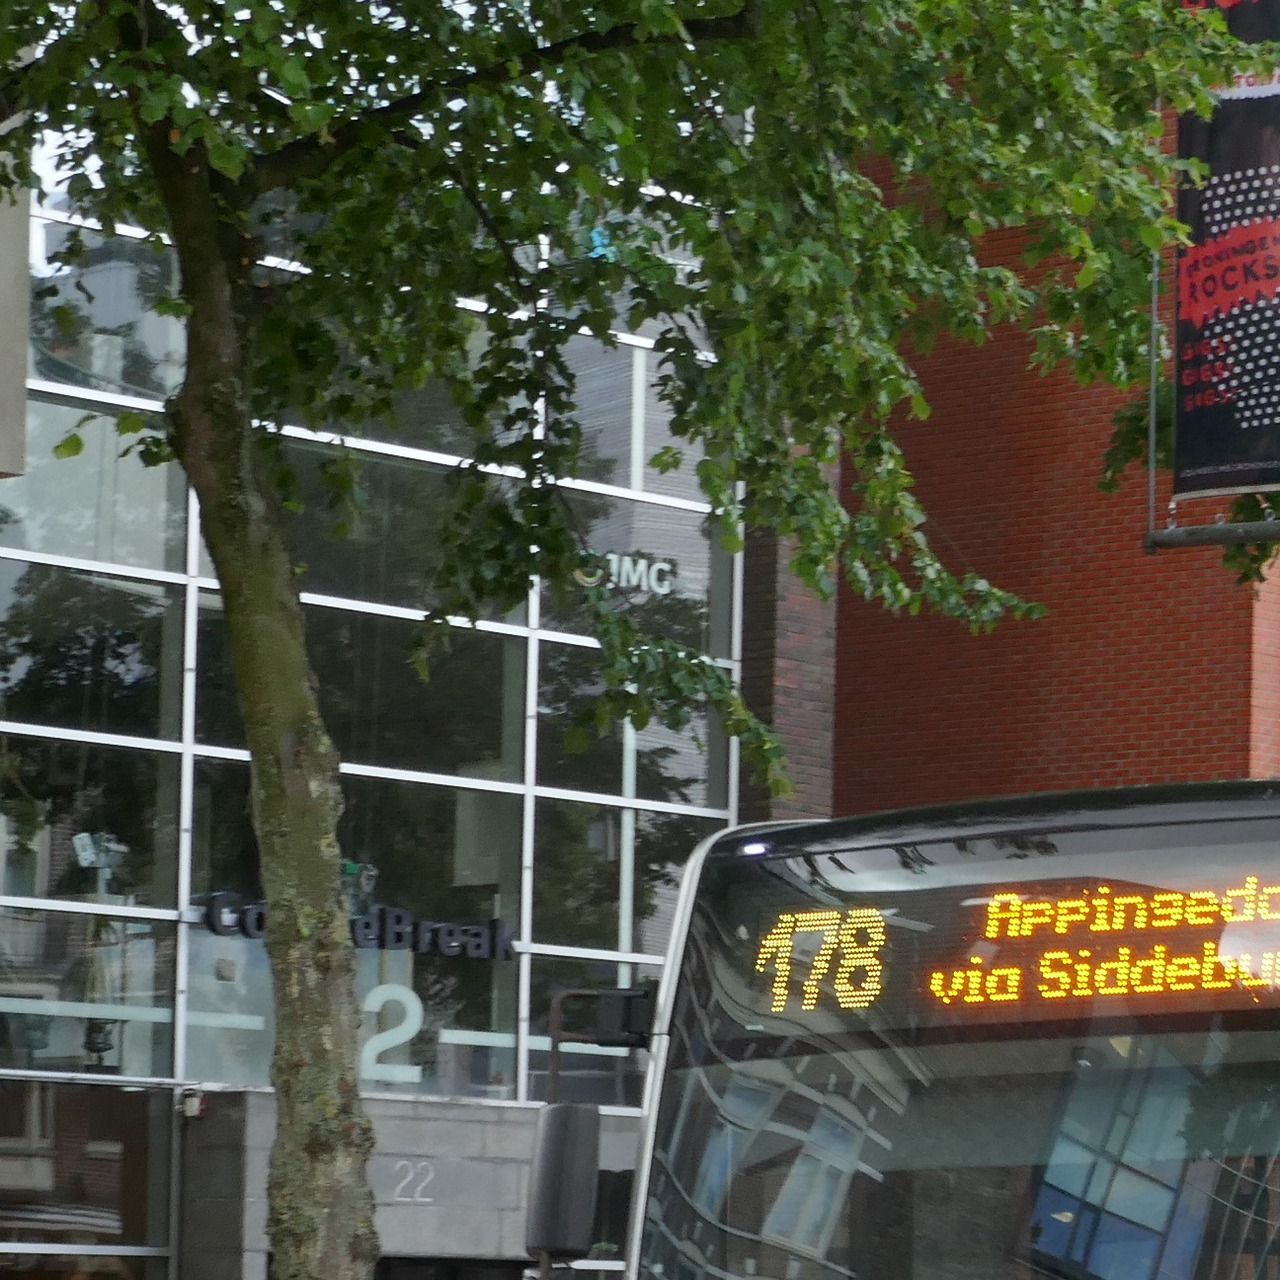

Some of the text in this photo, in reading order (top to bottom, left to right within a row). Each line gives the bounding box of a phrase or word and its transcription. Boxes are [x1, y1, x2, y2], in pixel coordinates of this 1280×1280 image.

[755, 907, 886, 1013] 178
[929, 956, 1021, 1004] via
[394, 1160, 435, 1201] 22
